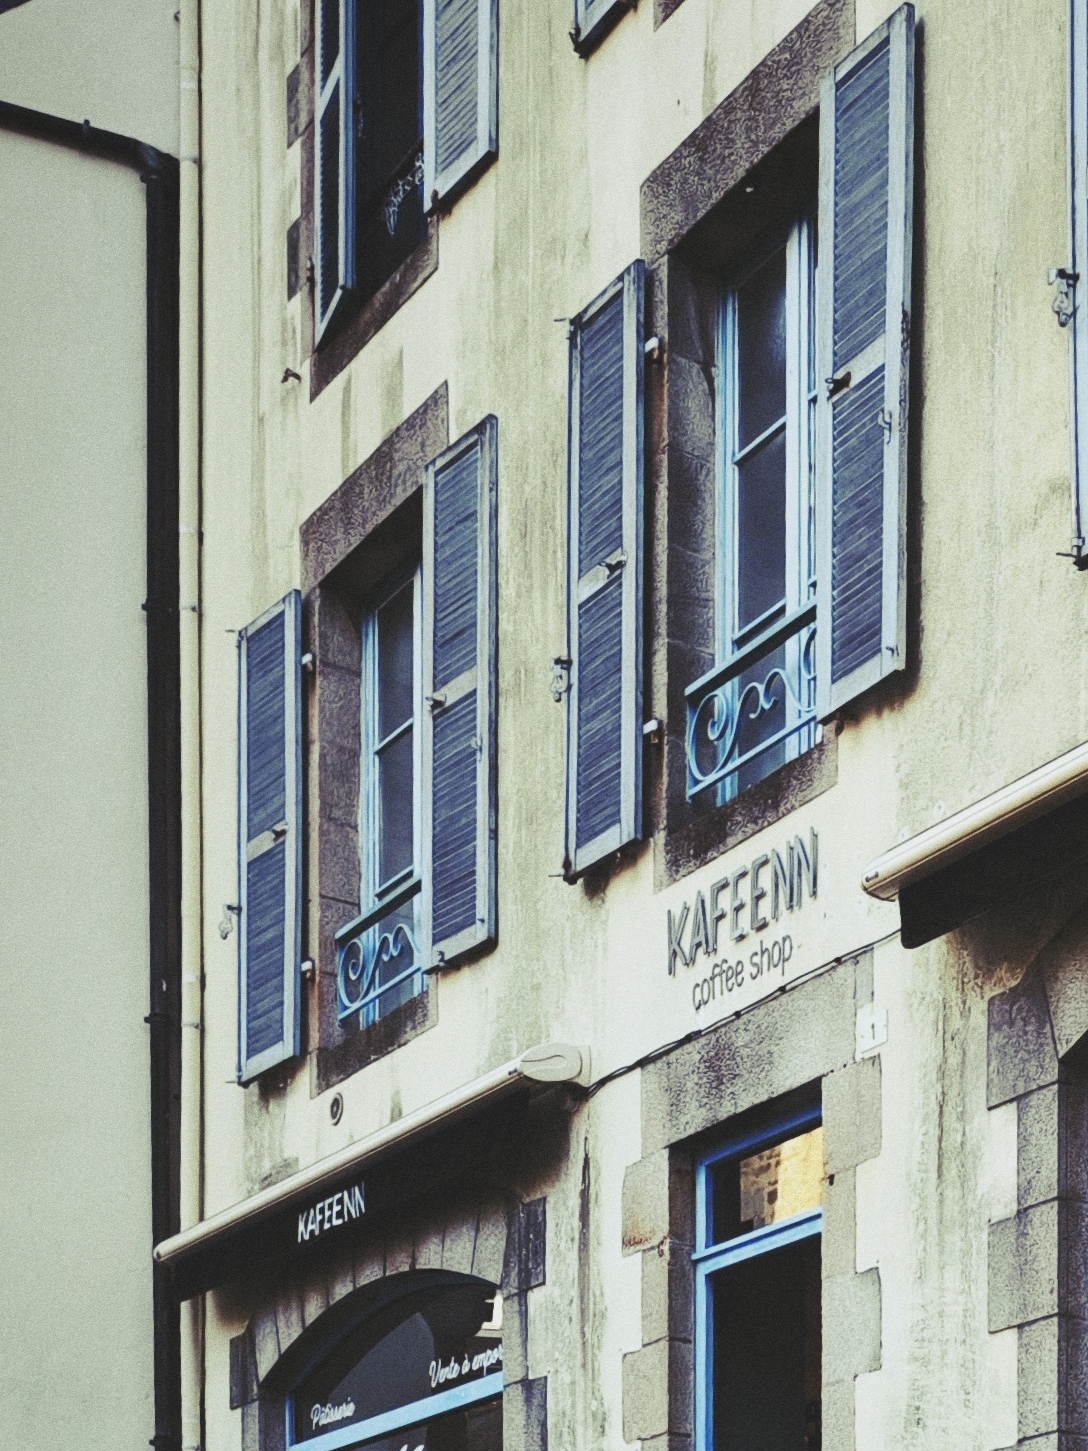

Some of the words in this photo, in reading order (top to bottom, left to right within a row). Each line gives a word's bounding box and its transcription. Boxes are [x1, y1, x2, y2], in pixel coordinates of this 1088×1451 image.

[667, 826, 818, 977] KAFEENN
[692, 958, 744, 1012] coffee
[750, 934, 793, 980] shop
[297, 1181, 366, 1243] KAFEENN
